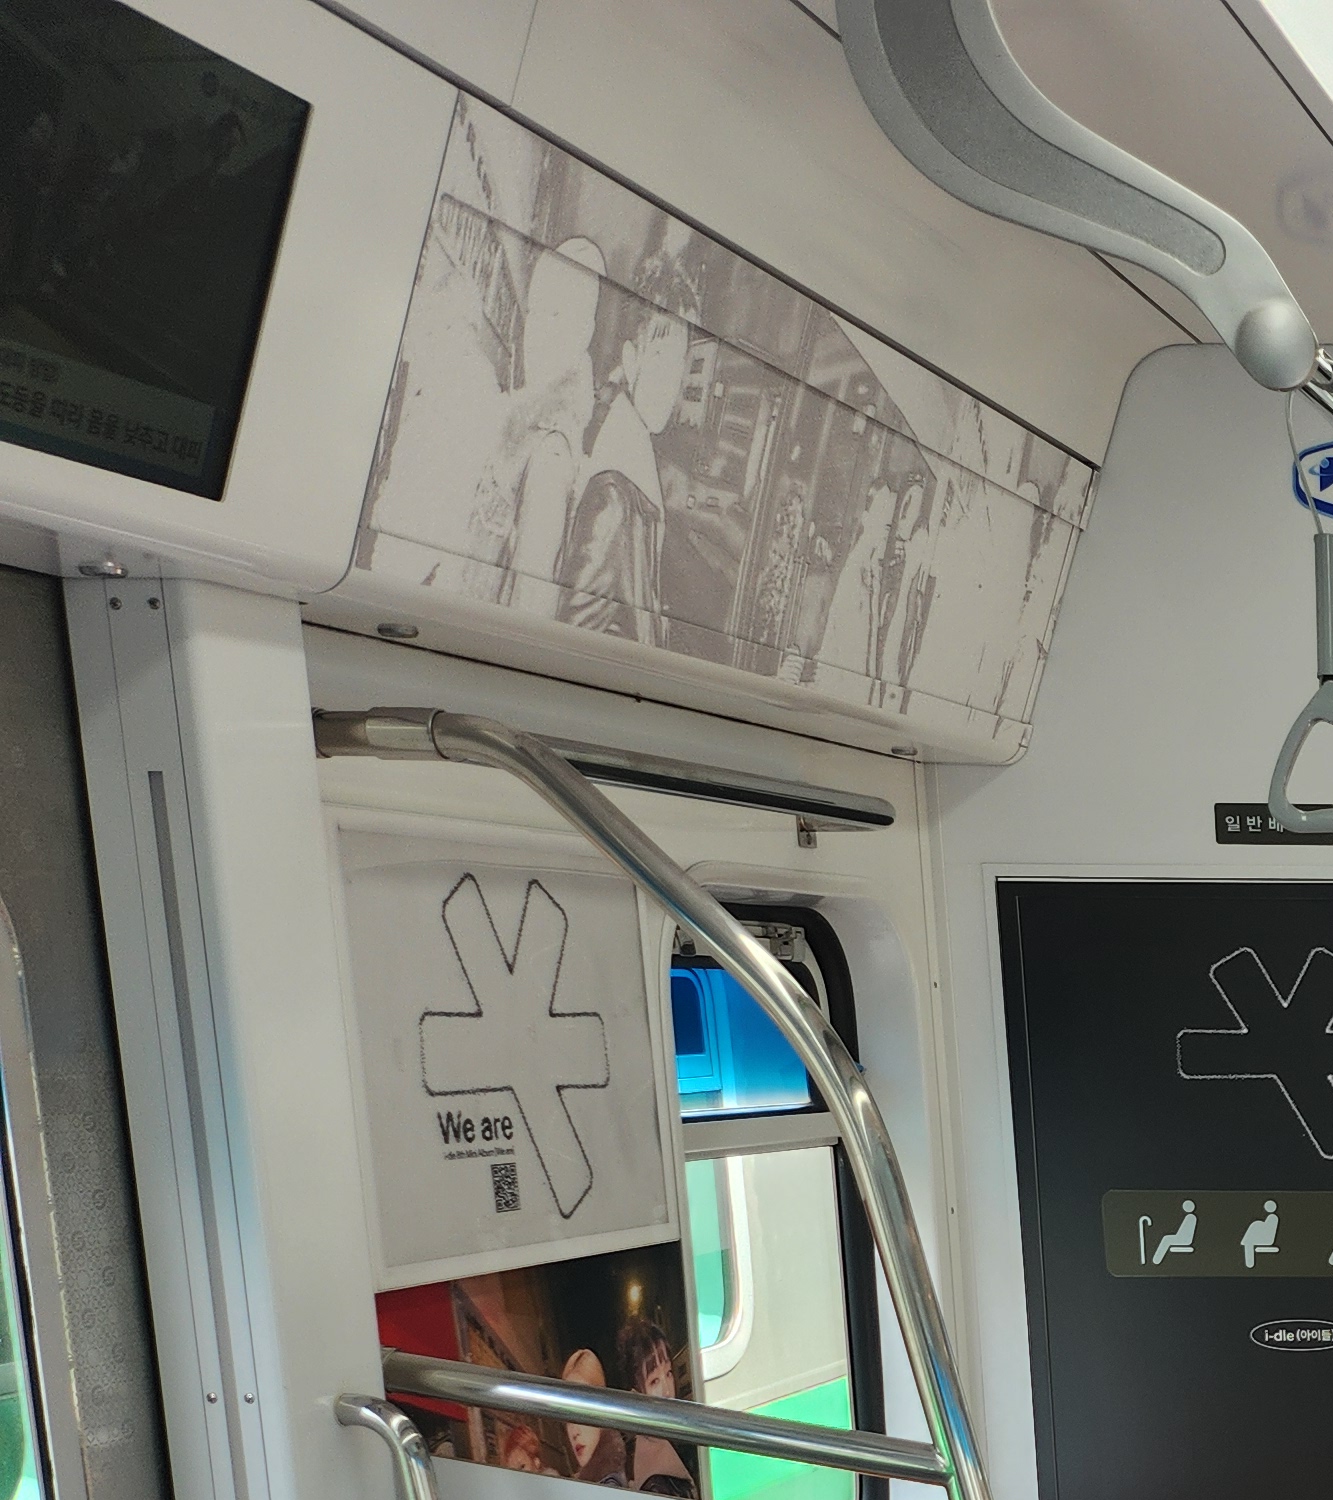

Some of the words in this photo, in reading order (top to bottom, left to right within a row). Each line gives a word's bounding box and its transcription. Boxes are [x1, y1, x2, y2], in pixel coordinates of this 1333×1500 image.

[437, 1110, 475, 1145] We
[481, 1116, 514, 1141] are
[1264, 1329, 1295, 1341] i-dle
